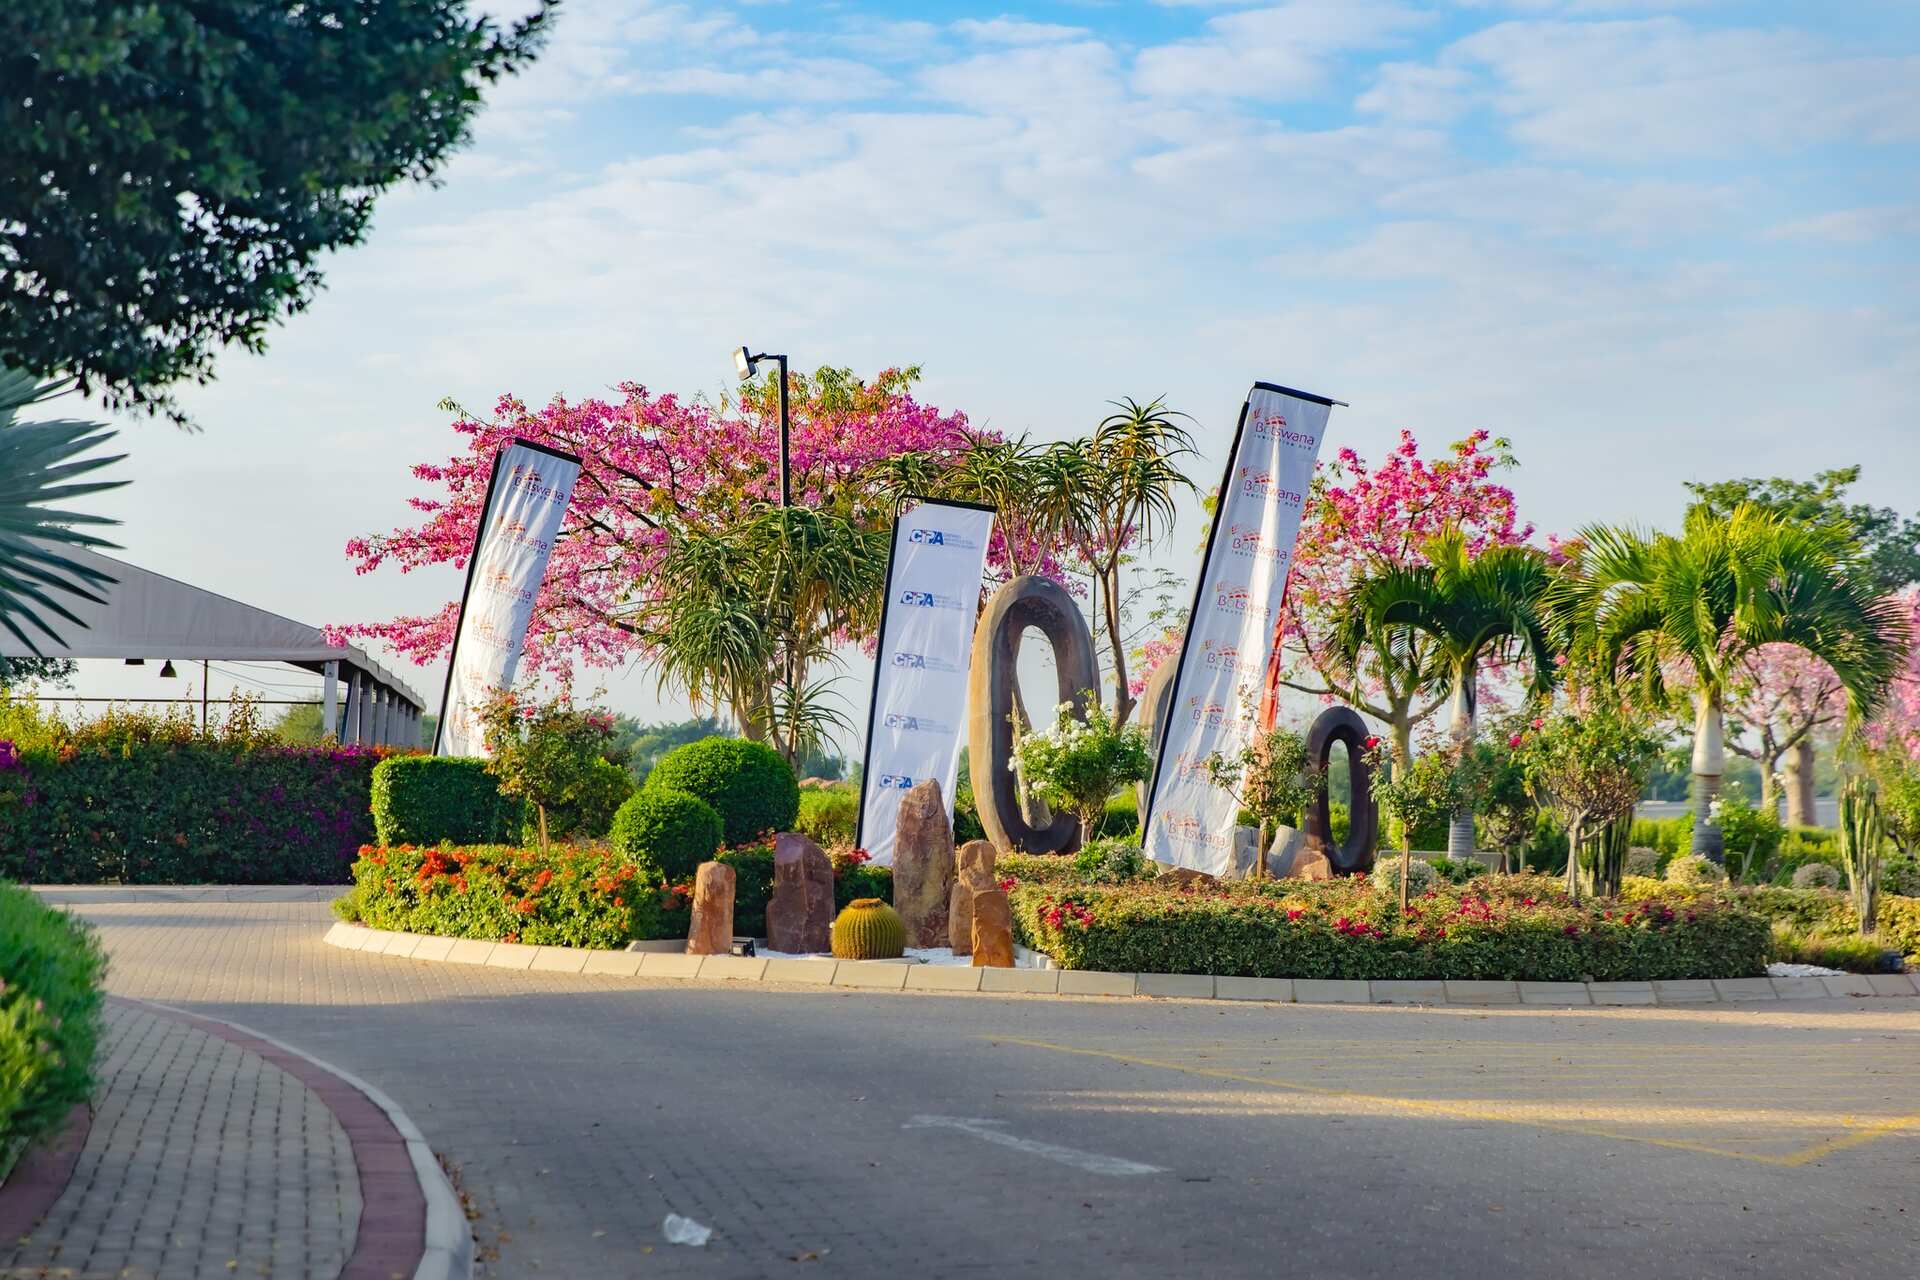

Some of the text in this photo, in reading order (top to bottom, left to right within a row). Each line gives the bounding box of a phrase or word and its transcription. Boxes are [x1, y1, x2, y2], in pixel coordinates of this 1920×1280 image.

[1255, 421, 1314, 446] Botswana
[514, 476, 564, 501] Botswana
[1243, 480, 1301, 502] Botswana
